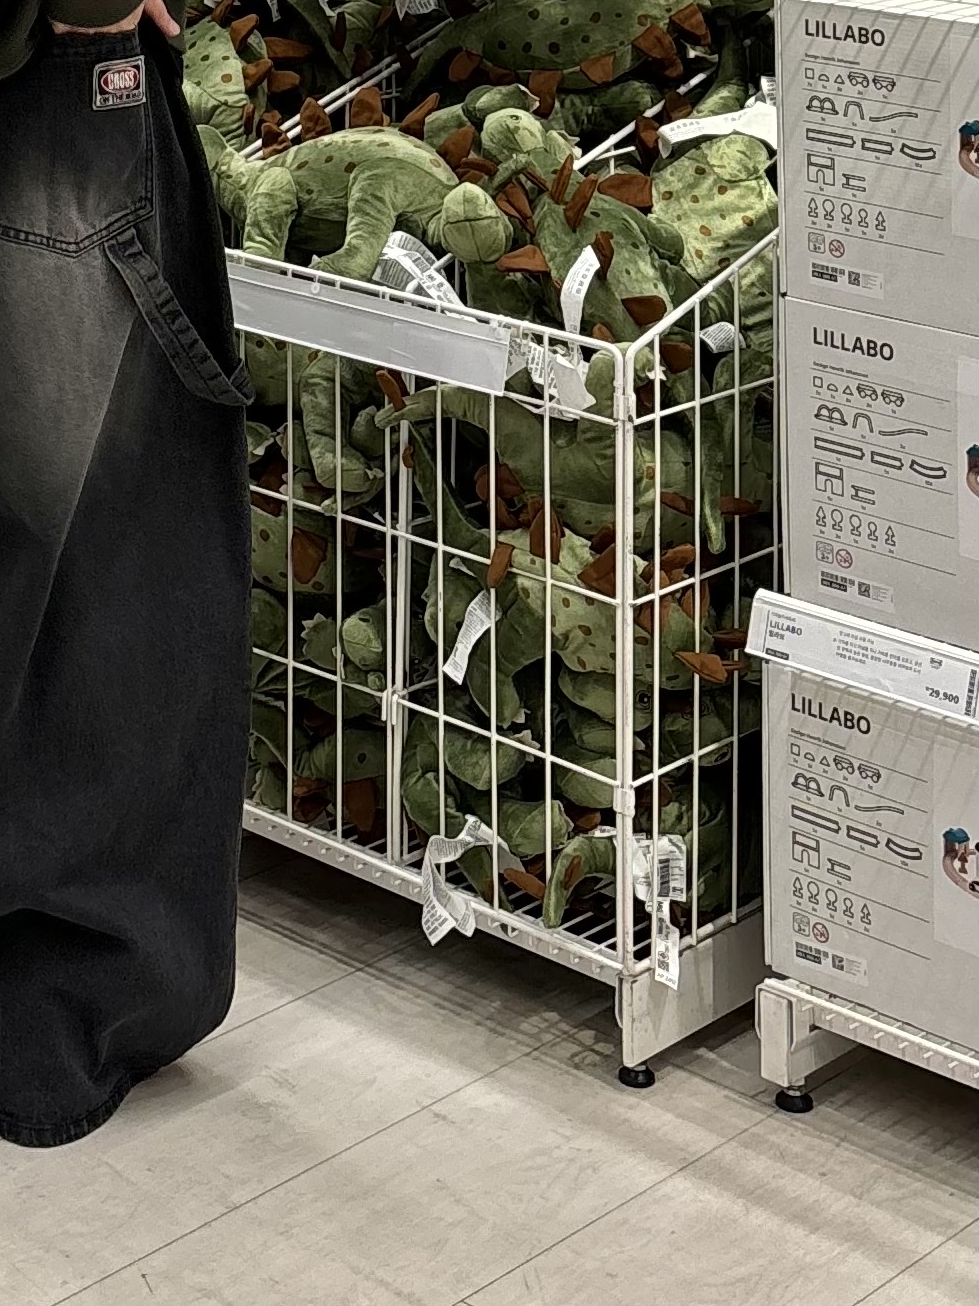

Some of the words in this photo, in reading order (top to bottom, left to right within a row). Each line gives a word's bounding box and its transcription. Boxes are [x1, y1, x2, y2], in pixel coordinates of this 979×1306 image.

[804, 18, 885, 47] LILLABO
[812, 326, 894, 361] LILLABO
[769, 620, 803, 636] LILLABO
[791, 692, 871, 735] LILLABO
